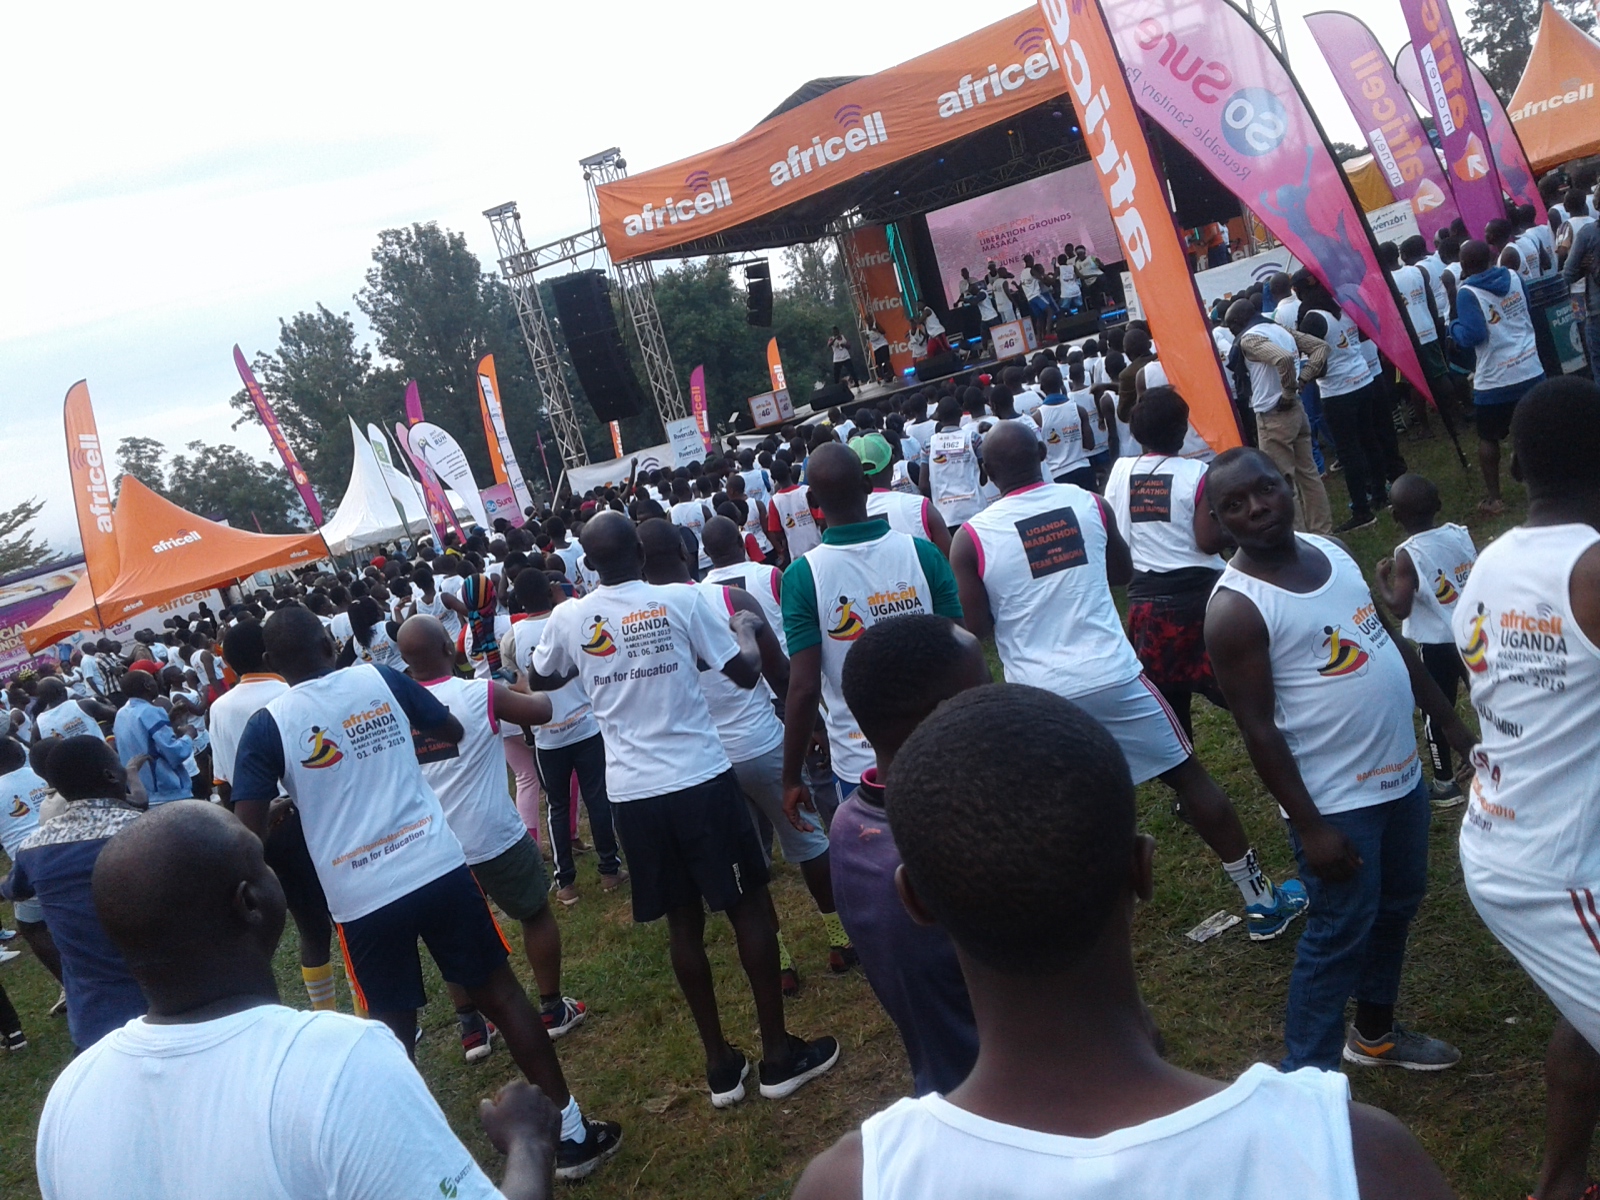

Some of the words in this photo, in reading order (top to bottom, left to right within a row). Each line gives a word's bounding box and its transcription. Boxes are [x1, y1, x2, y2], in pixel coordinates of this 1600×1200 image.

[1510, 83, 1594, 123] africell
[768, 111, 888, 187] africell
[622, 177, 733, 237] africell
[980, 227, 1026, 245] LIBERATION
[1029, 212, 1072, 230] GROUNDS
[982, 237, 1019, 252] MASAKA
[1000, 255, 1020, 267] JUNE
[1004, 338, 1015, 349] 4G
[78, 434, 114, 533] africell
[496, 496, 513, 507] Sure
[1024, 526, 1079, 549] MARATHON
[1026, 519, 1067, 536] UGANDA
[152, 531, 202, 553] africell
[1031, 558, 1052, 570] TEAM
[867, 585, 917, 606] africell
[621, 606, 667, 625] africell
[870, 597, 923, 617] UGANDA
[622, 617, 670, 635] UGANDA
[1500, 610, 1562, 636] africell
[624, 631, 656, 643] MARATHON
[657, 628, 671, 636] 2019
[1501, 630, 1568, 655] UGANDA
[627, 650, 640, 658] 01.
[641, 647, 654, 656] 06.
[655, 643, 674, 653] 2019
[594, 673, 611, 686] Run
[613, 671, 628, 682] for
[630, 662, 679, 680] Education
[341, 702, 392, 729] africell
[345, 713, 397, 738] UGANDA
[350, 729, 387, 746] MARATHON
[358, 742, 370, 750] RACE
[371, 738, 381, 746] LIKE
[389, 731, 402, 739] OTHER
[357, 749, 371, 760] 01.
[373, 745, 386, 754] 06.
[387, 737, 406, 748] 2019
[1380, 778, 1400, 790] Run
[1401, 772, 1410, 784] for
[351, 857, 368, 869] Run
[369, 850, 382, 862] for
[384, 829, 425, 856] Education
